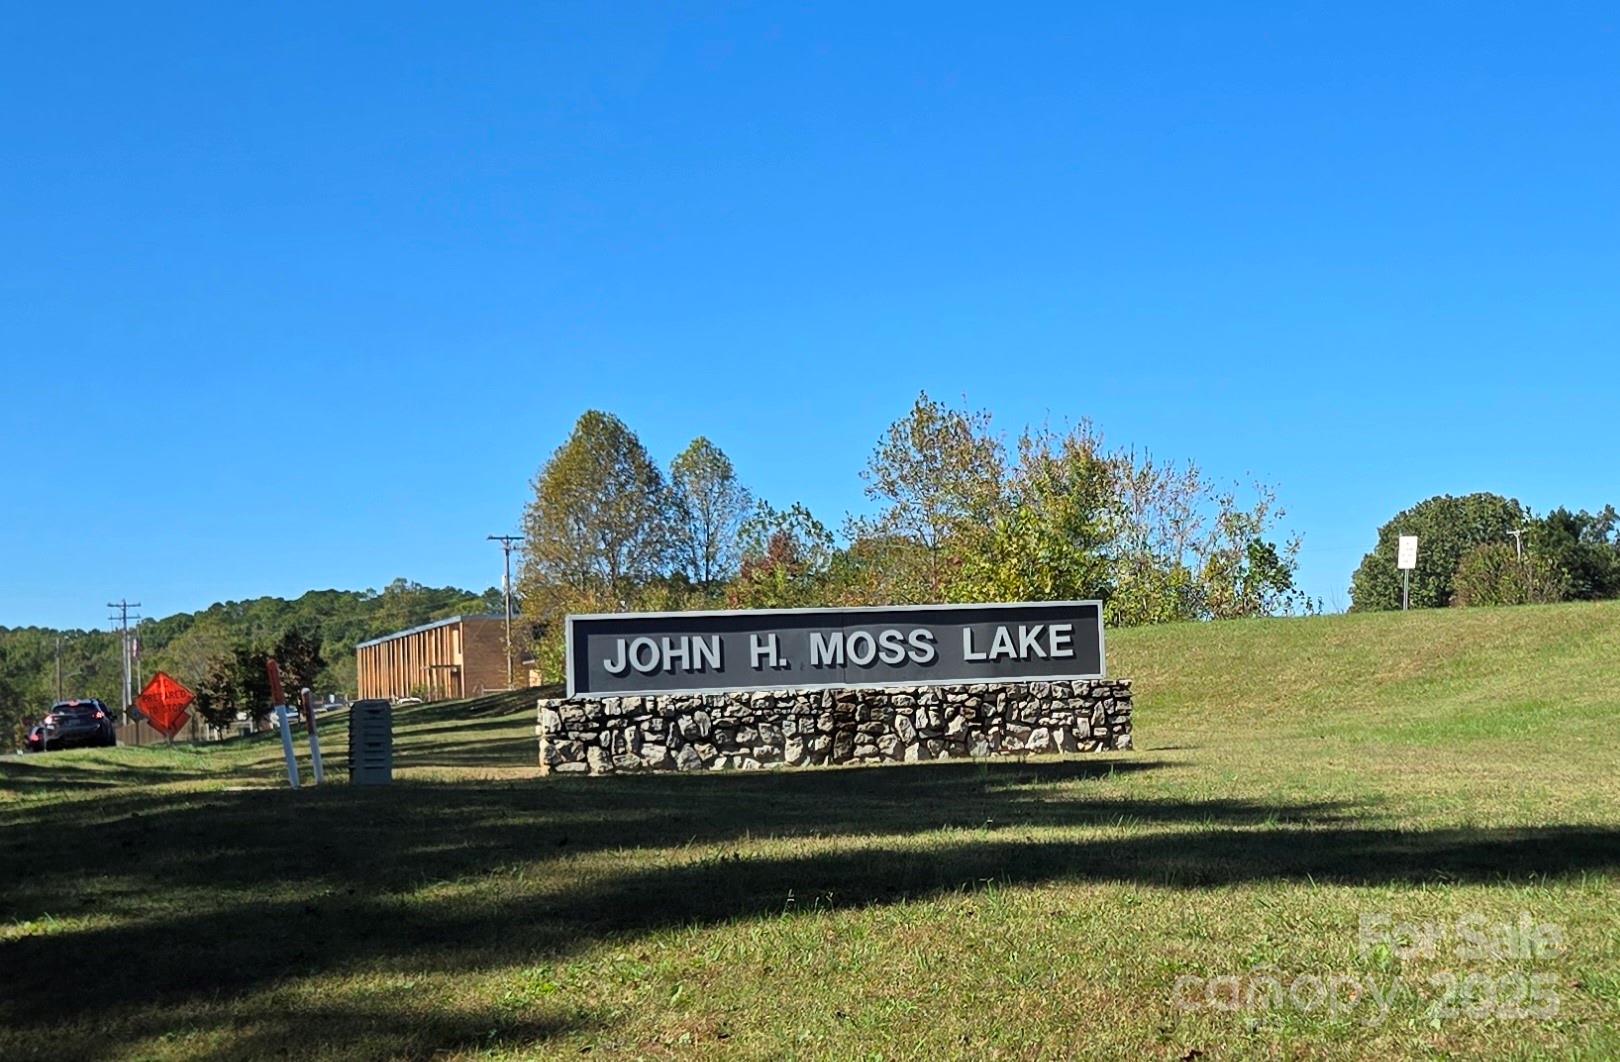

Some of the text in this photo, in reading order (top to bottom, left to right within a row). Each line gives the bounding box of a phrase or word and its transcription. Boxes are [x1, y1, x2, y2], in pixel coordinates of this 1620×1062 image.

[603, 623, 1074, 674] JOHN H. MOSS LAKE
